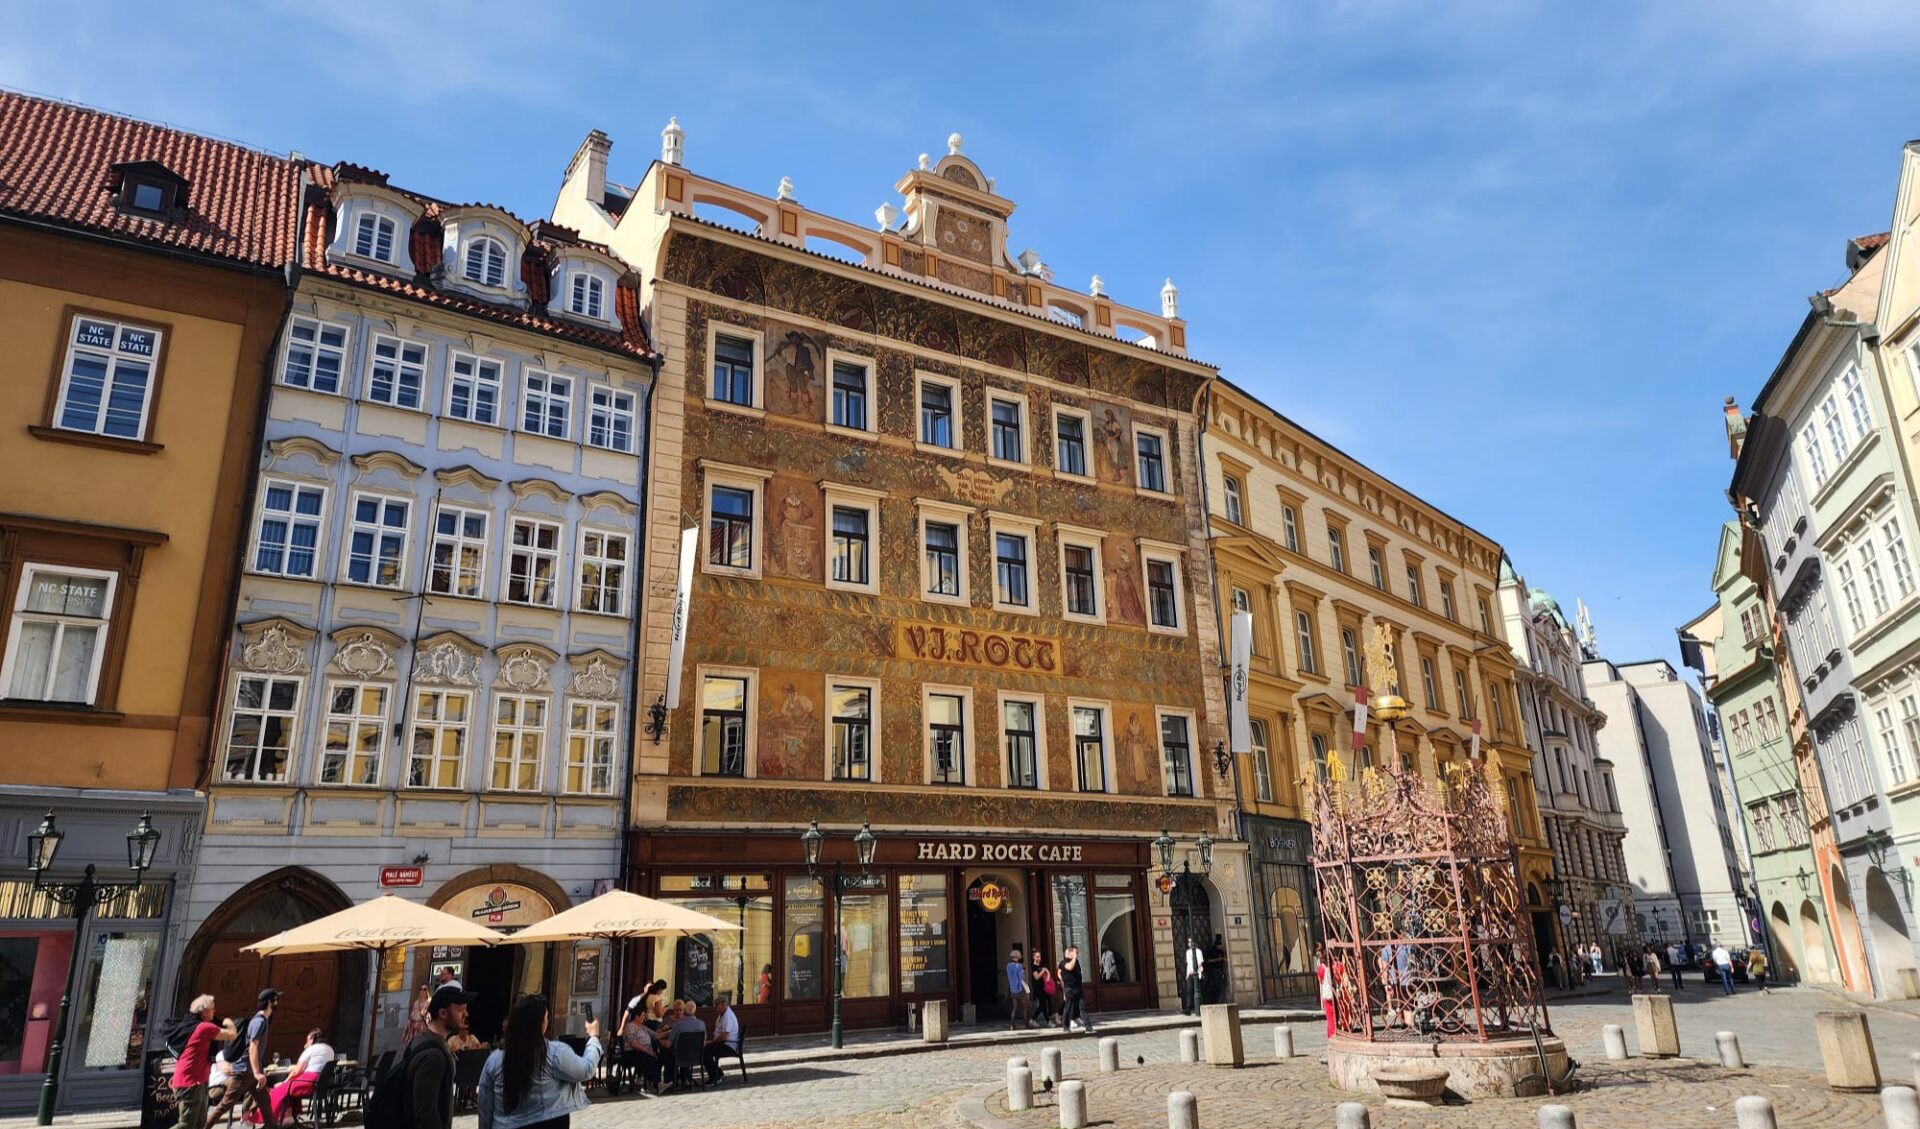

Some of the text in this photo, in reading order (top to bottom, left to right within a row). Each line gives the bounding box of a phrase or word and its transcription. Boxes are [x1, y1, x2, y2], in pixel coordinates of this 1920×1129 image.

[89, 325, 105, 335] NC
[79, 333, 111, 346] STATE
[130, 333, 145, 343] NC
[120, 341, 151, 354] STATE
[38, 582, 98, 598] NC STATE
[39, 593, 96, 608] ERSITY
[917, 843, 1082, 861] HARD ROCK CAFE
[972, 887, 1009, 900] Hard Rock
[593, 917, 669, 929] Coca-Cola
[334, 926, 428, 939] Coca-Cola
